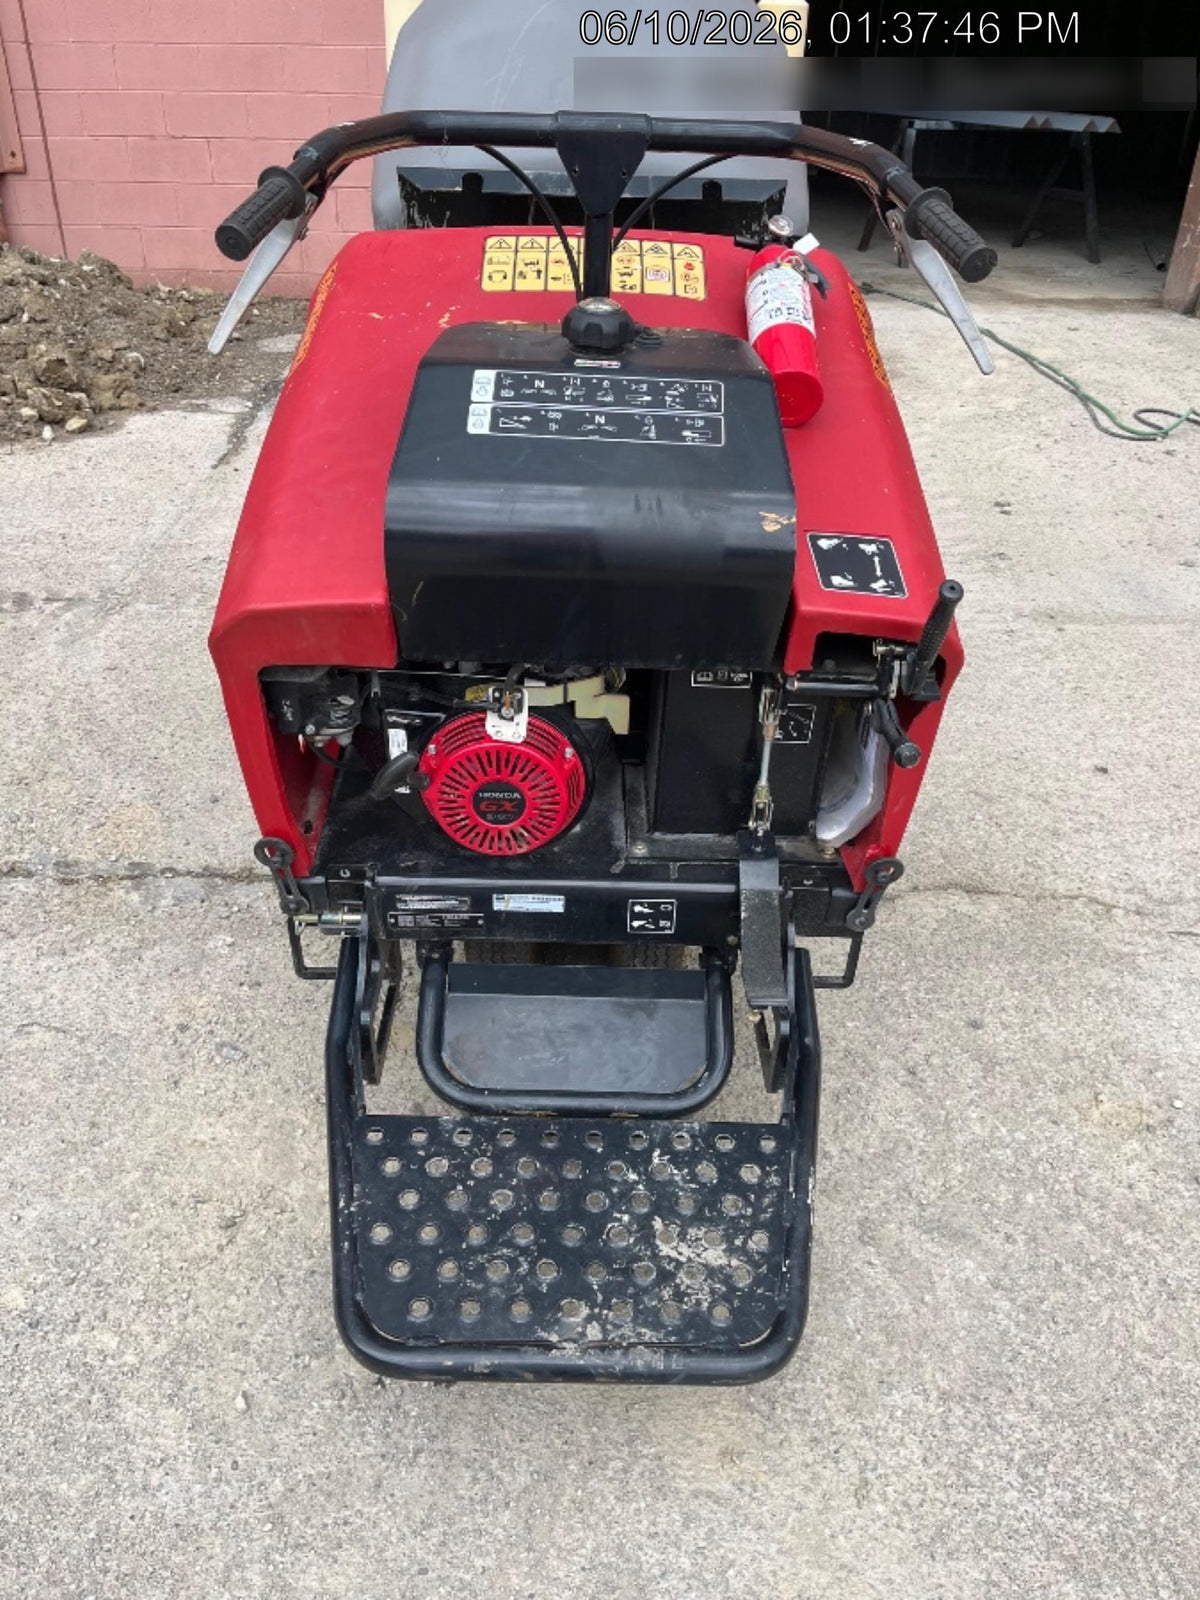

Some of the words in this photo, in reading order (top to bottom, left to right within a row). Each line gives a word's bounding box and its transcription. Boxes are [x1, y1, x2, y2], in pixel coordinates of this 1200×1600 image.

[534, 379, 545, 388] N
[595, 415, 605, 424] N
[479, 791, 521, 799] HONDA
[479, 801, 518, 812] GX
